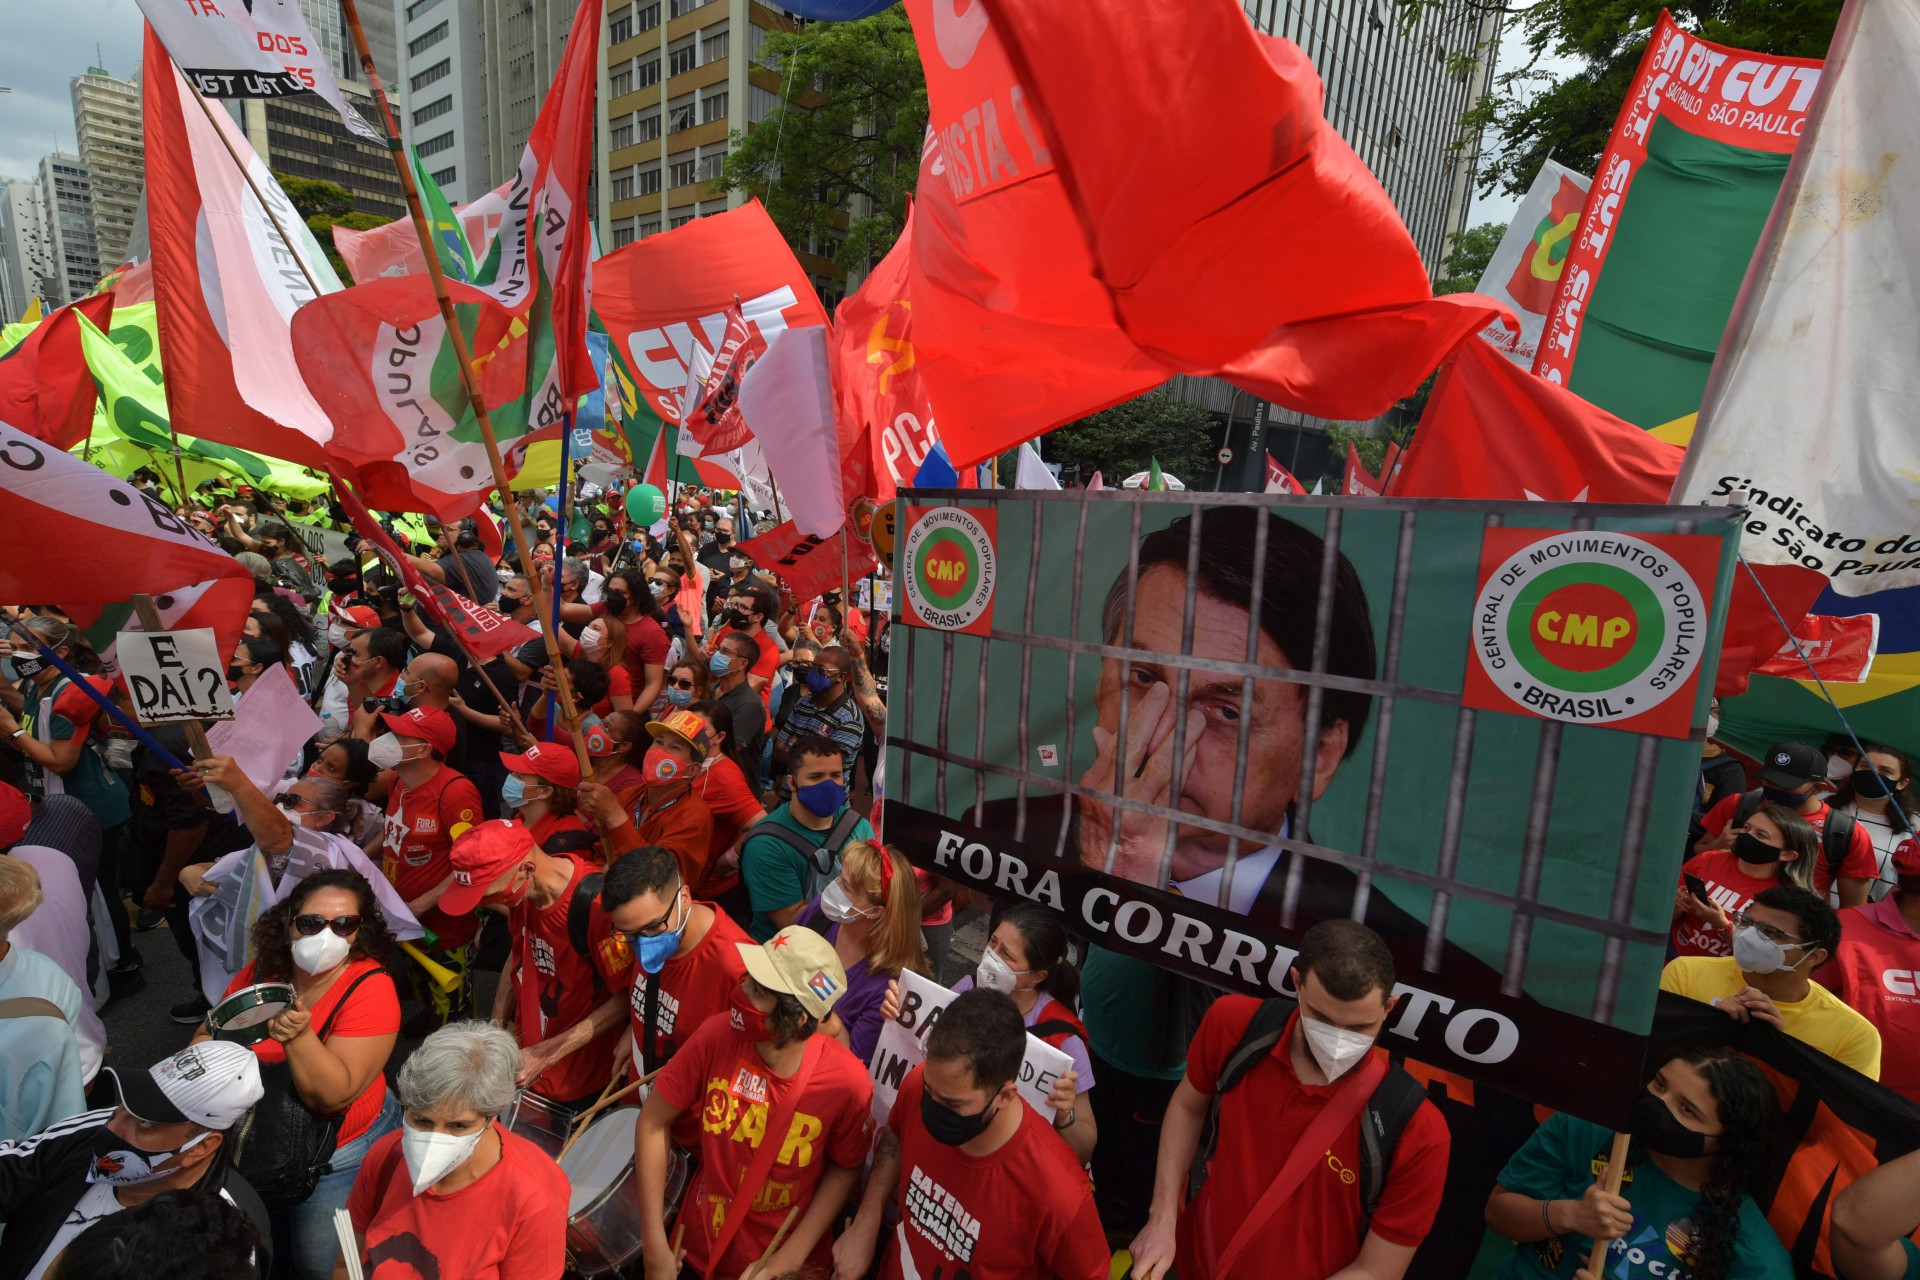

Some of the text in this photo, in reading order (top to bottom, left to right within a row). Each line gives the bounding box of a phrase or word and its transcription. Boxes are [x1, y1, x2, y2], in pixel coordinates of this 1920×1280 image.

[257, 31, 308, 56] DOS
[244, 74, 283, 95] UGT
[1623, 26, 1672, 137] SÃO PAULO
[1679, 41, 1728, 93] CUT
[1721, 60, 1823, 113] CUT
[1665, 81, 1703, 116] SÃO PAULO
[1707, 102, 1740, 126] SÃO
[1580, 152, 1620, 250] SÃO PAULO
[1589, 159, 1631, 259] CUT
[1562, 263, 1579, 297] SÃO
[1548, 298, 1567, 350] PAULO
[1556, 269, 1590, 359] CUT
[1251, 402, 1264, 437] Paulista
[1711, 476, 1866, 553] Sindicato
[906, 548, 916, 598] CENTRAL
[911, 528, 922, 544] DE
[923, 512, 979, 536] MOVIMENTOS
[975, 537, 992, 607] POPULARES
[1771, 527, 1824, 570] São
[926, 558, 965, 582] CMP
[923, 607, 967, 627] BRASIL
[1481, 539, 1695, 691] CENTRAL DE MOVIMENTOS POPULARES
[1537, 610, 1631, 648] CMP
[148, 635, 184, 669] E
[130, 667, 222, 712] DAÍ?
[1522, 685, 1623, 718] BRASIL
[416, 817, 437, 829] FORA
[934, 829, 1520, 1064] FORA CORRUTO
[635, 973, 679, 1015] BAERIA
[732, 1083, 765, 1103] BOLSONARO
[736, 1067, 767, 1095] FORA
[908, 1182, 973, 1250] ZUMBI DOS
[911, 1164, 981, 1241] BATERIA
[905, 1192, 972, 1262] PALMARES
[921, 1229, 944, 1251] PAULO
